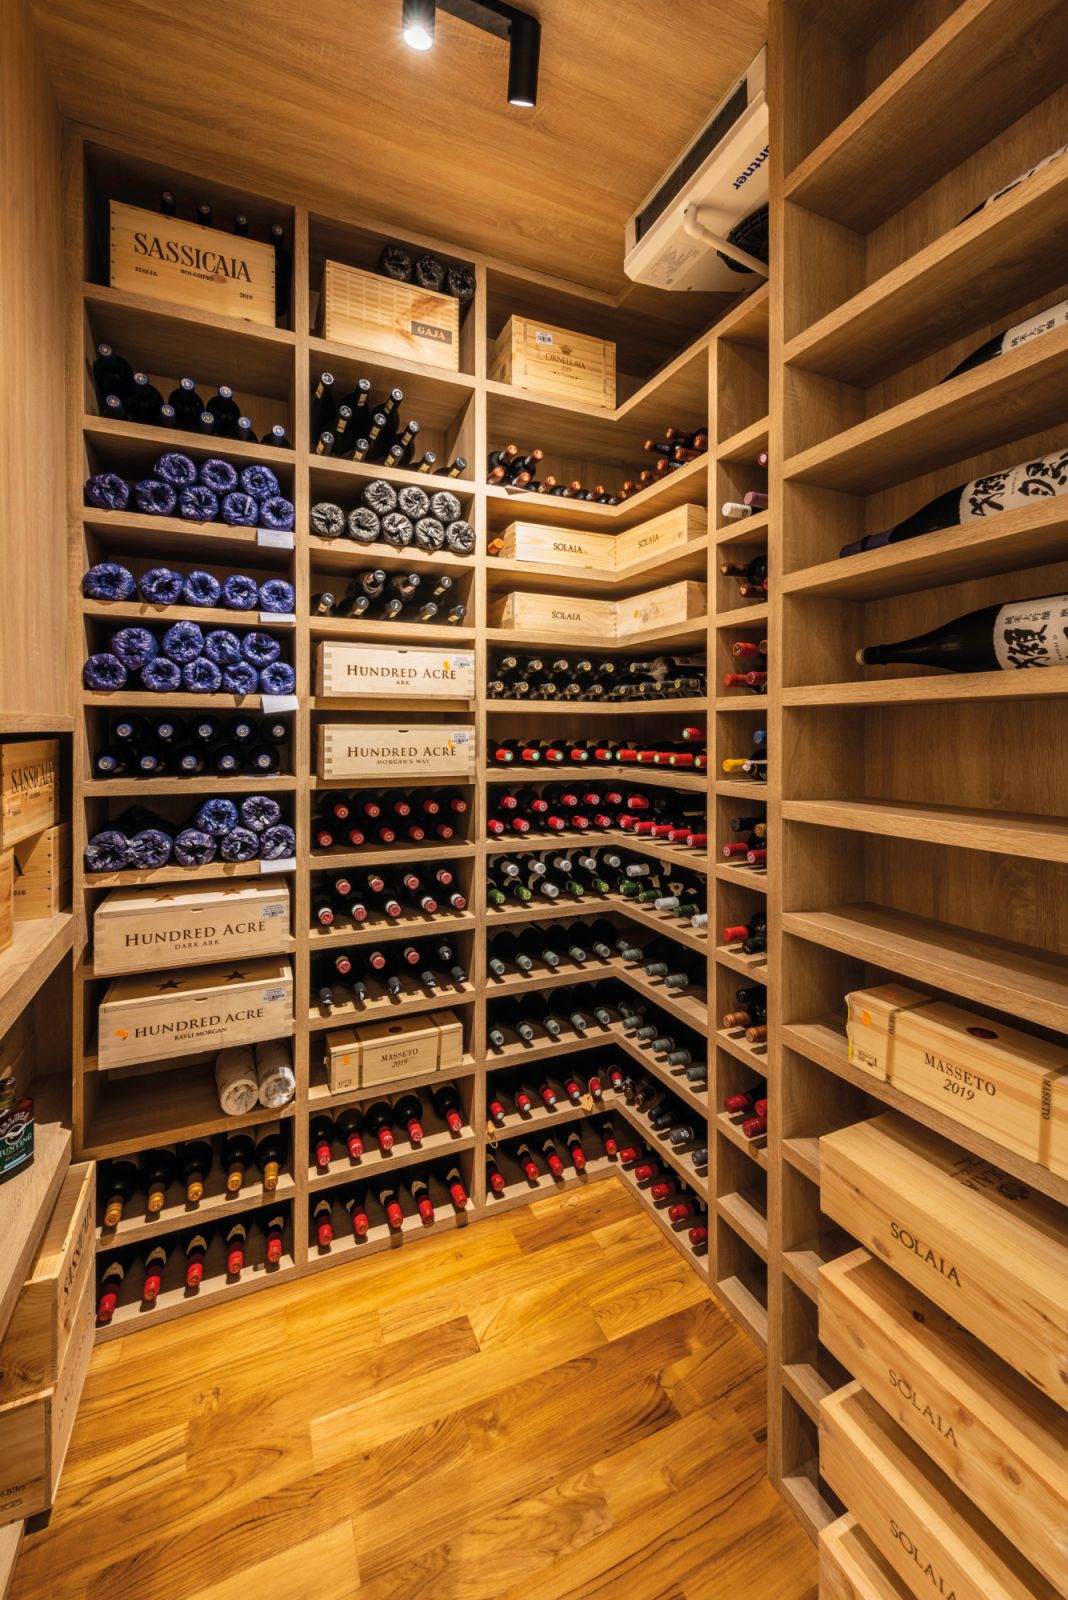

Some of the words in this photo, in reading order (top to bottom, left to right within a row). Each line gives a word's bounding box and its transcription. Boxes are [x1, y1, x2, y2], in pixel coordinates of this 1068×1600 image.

[732, 144, 770, 190] ntner
[133, 232, 253, 283] SASSICAIA
[135, 266, 158, 277] ITALIA
[416, 325, 447, 341] GAJA
[545, 353, 586, 370] ORNELLAIA
[553, 542, 583, 554] SOLAIA
[638, 533, 660, 549] SOLAIA
[552, 610, 581, 621] SOLAIA
[347, 664, 417, 679] HUNDRED
[423, 668, 457, 680] ACRE
[347, 746, 418, 758] HUNDRED
[423, 746, 457, 757] ACRE
[124, 926, 216, 947] HUNDRED
[223, 920, 266, 936] ACRE
[174, 941, 200, 950] DARK
[134, 1015, 221, 1038] HUNDRED
[225, 1008, 264, 1023] ACRE
[174, 1033, 195, 1041] KAYLI
[196, 1027, 228, 1037] MORGAN
[380, 1048, 419, 1062] MASSETO
[924, 1052, 997, 1097] MASSETO
[943, 1078, 976, 1101] 2019
[889, 1220, 962, 1288] SOLAIA
[888, 1368, 960, 1449] SOLAIA
